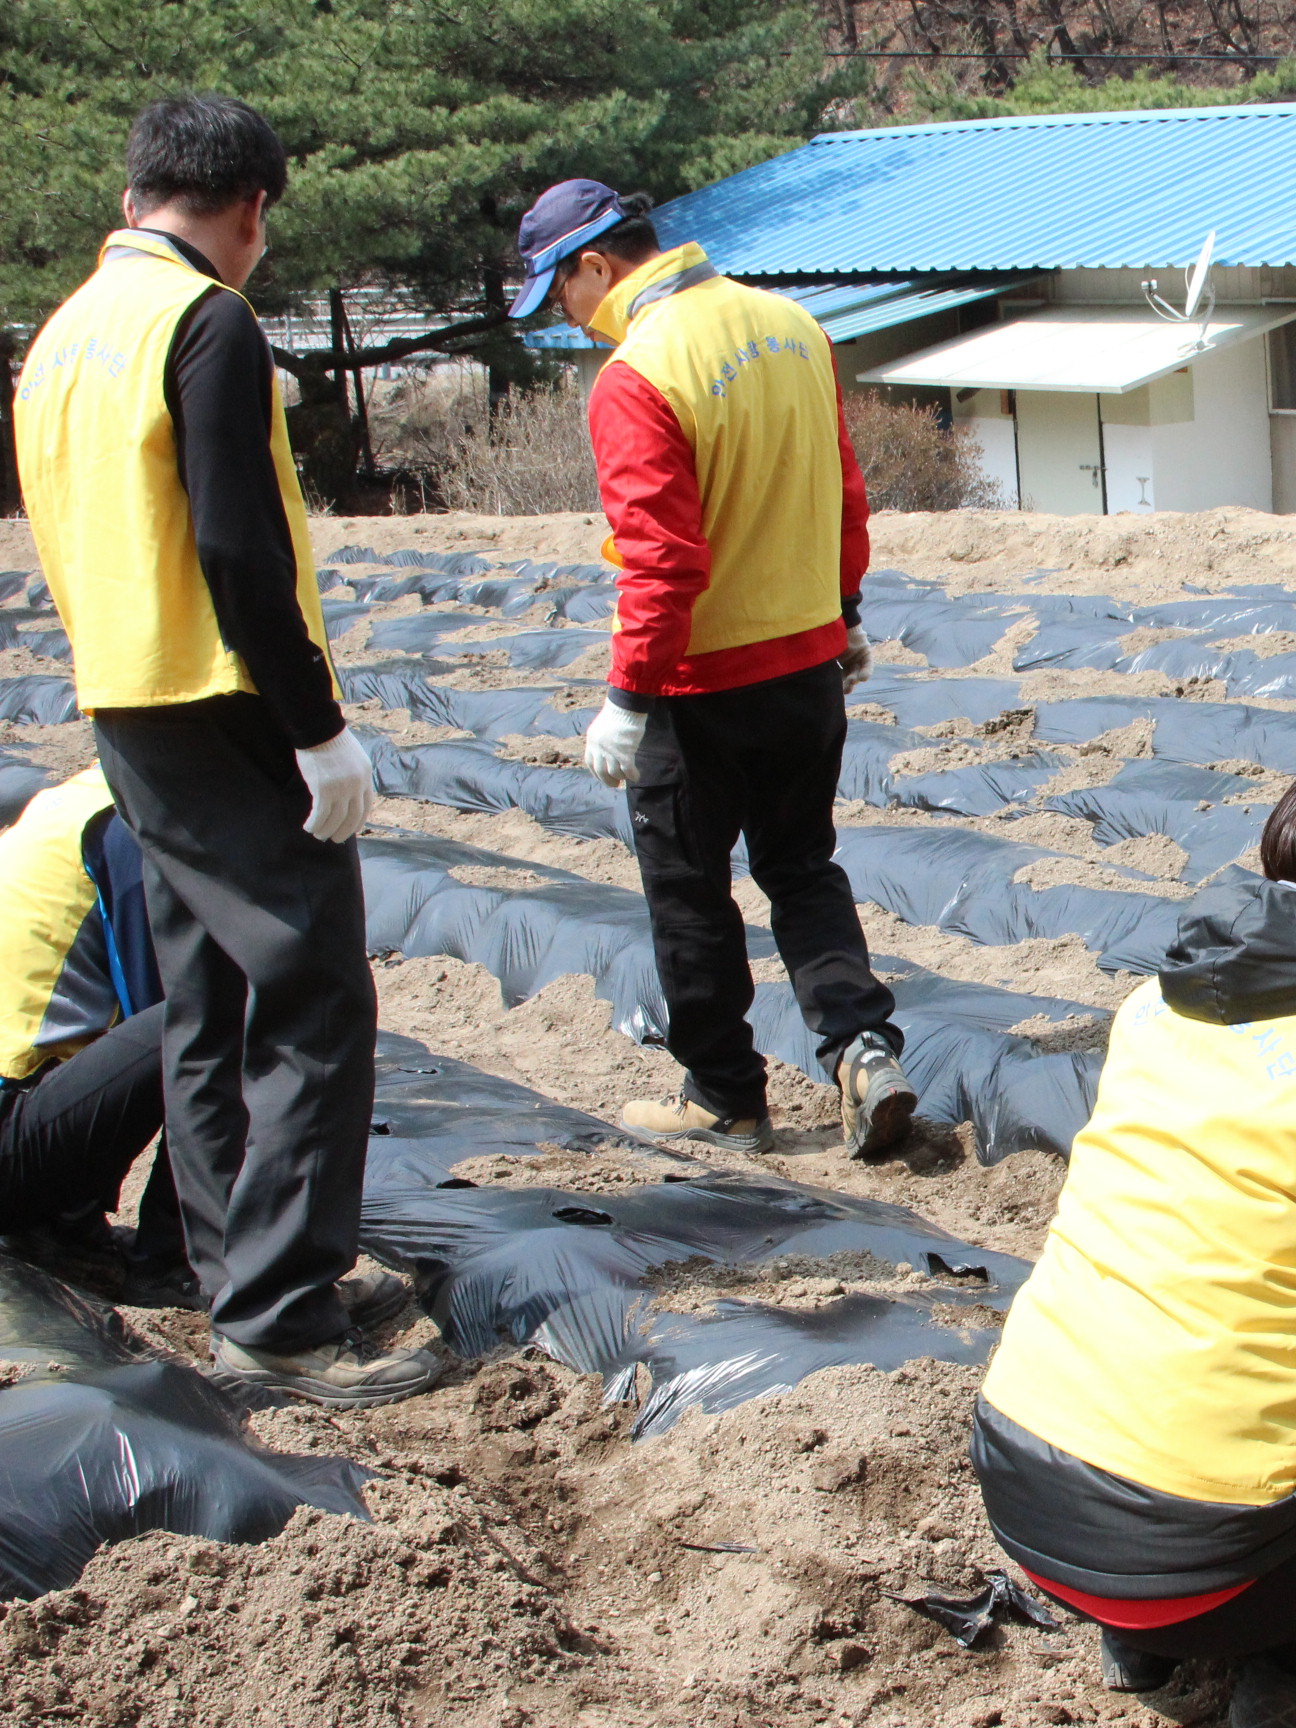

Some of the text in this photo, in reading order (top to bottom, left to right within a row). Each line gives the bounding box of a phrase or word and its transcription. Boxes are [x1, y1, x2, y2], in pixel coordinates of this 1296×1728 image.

[20, 362, 45, 401] 안전
[85, 338, 128, 378] 봉사단
[711, 336, 809, 397] 안전 사랑 봉사단
